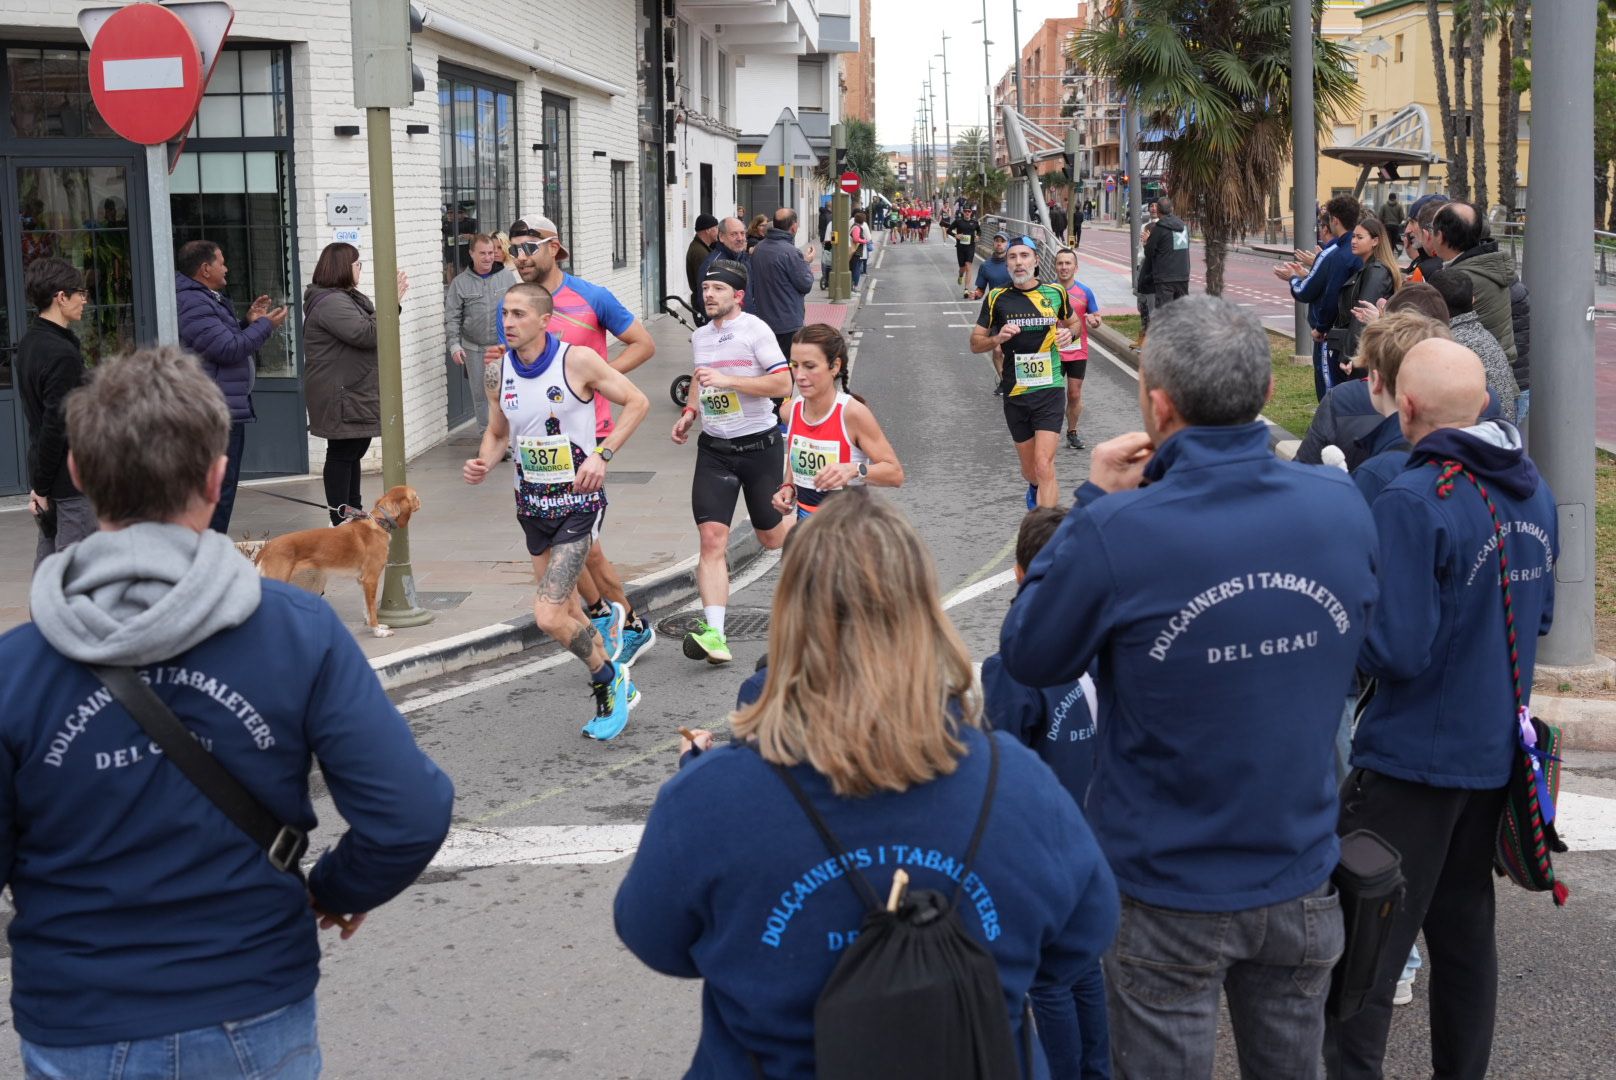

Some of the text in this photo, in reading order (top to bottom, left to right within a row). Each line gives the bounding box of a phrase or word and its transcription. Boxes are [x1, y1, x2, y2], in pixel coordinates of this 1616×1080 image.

[1023, 361, 1045, 374] 303
[707, 394, 730, 410] 569
[524, 464, 563, 472] ALEJANDRO
[528, 448, 558, 466] 387
[798, 450, 826, 470] 590
[1148, 572, 1350, 661] DOLÇAINERS I TABALETERS
[1207, 630, 1318, 664] DEL GRAU
[44, 670, 151, 767] DOLÇAINS
[167, 666, 276, 750] TABALETERS
[1046, 684, 1084, 741] DOLÇAINE
[95, 745, 143, 770] DEL
[892, 844, 1001, 942] TABALETERS
[828, 930, 859, 951] DE
